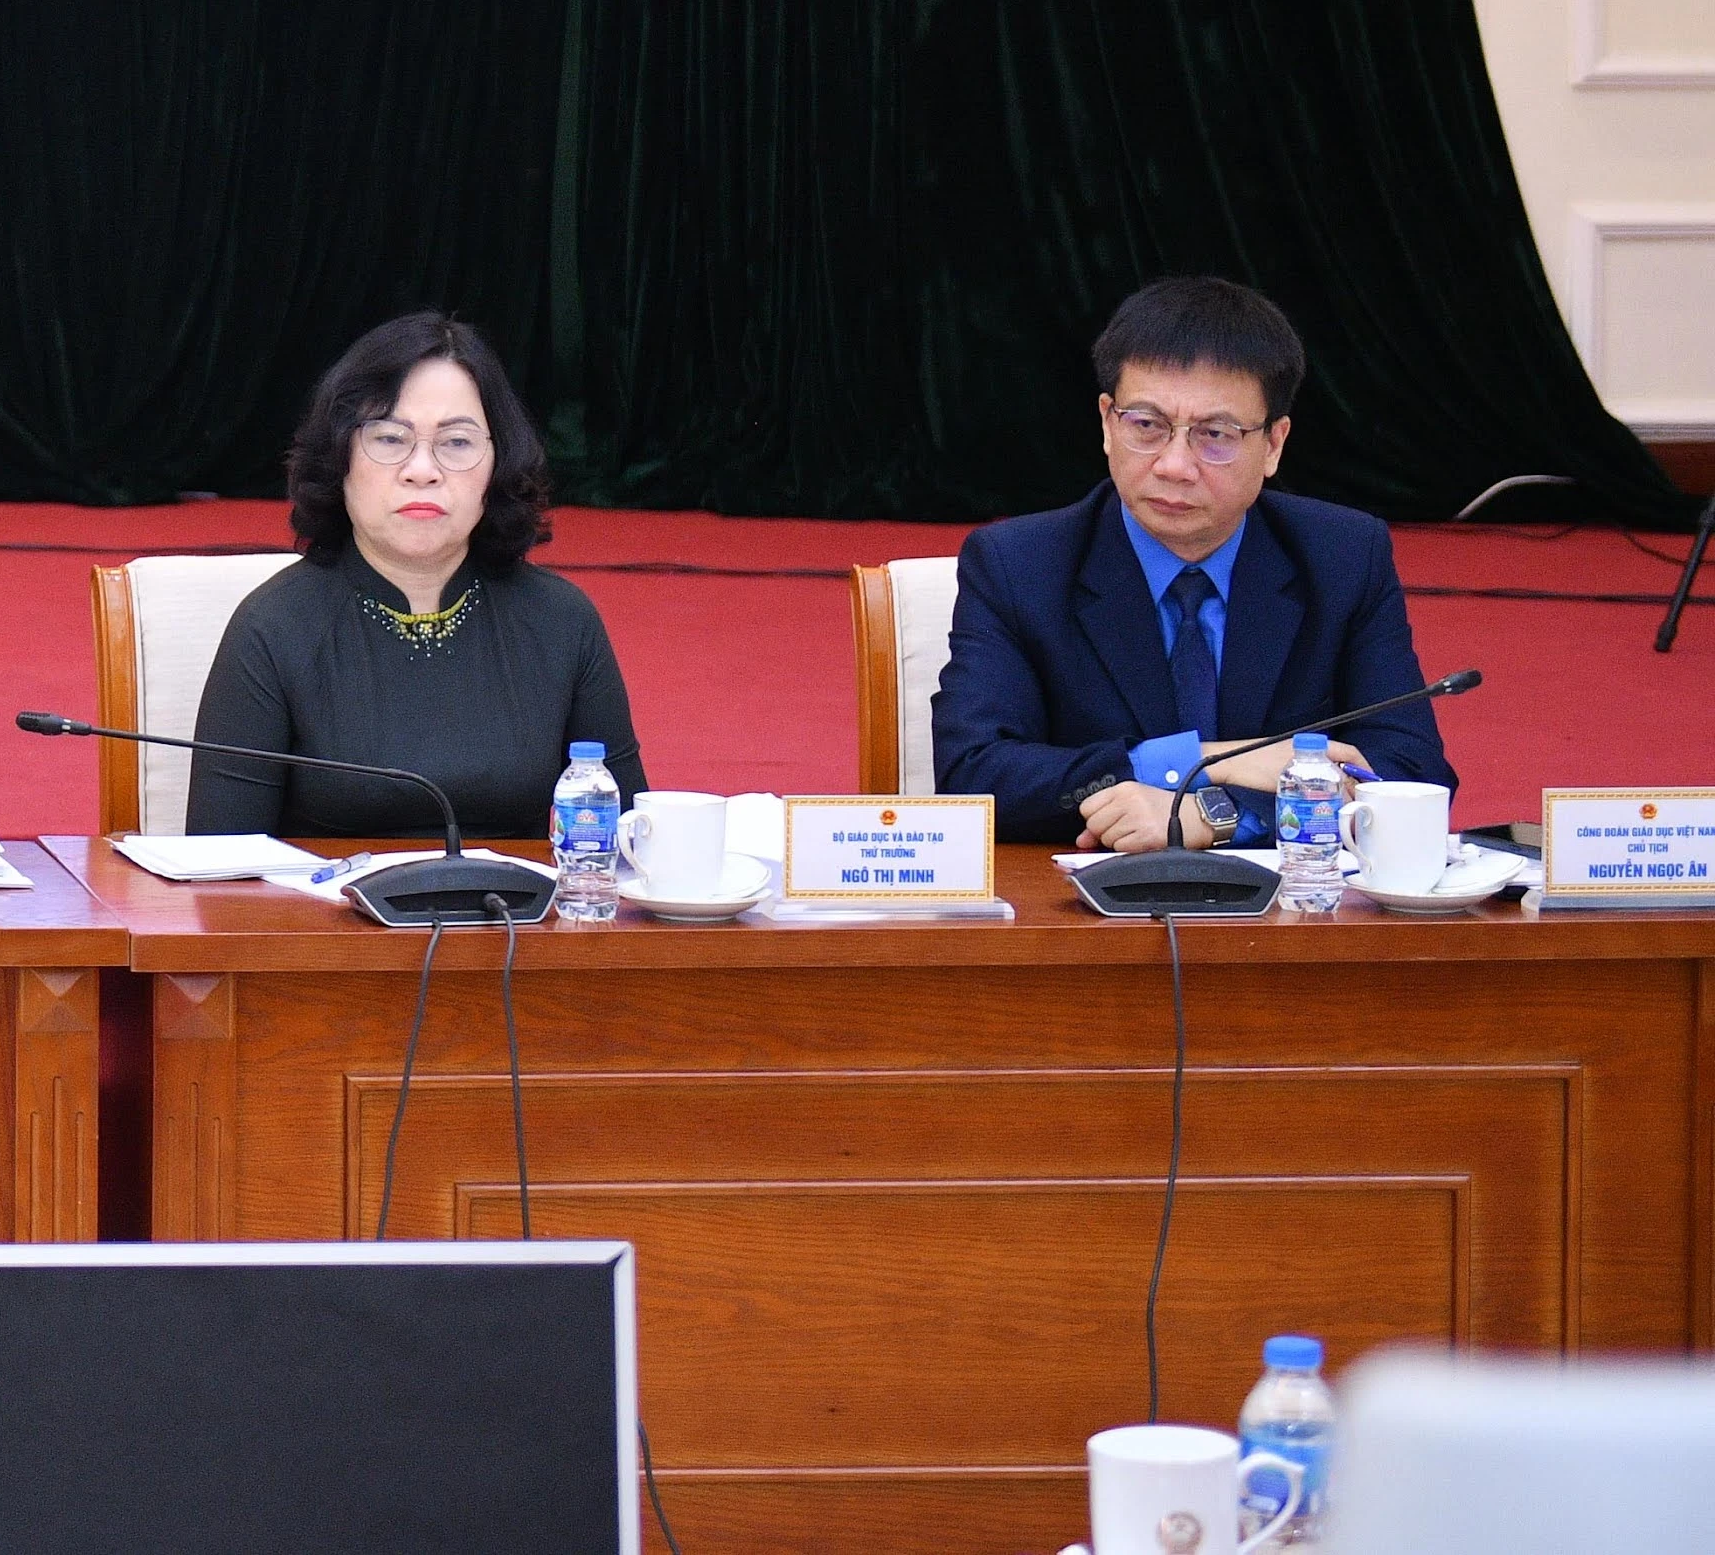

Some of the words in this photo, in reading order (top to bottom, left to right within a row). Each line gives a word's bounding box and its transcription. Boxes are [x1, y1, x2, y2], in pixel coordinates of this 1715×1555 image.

[833, 831, 844, 844] BỘ
[848, 830, 868, 842] GIÁO
[871, 832, 889, 844] DỤC
[892, 830, 903, 842] VÀ
[906, 830, 924, 842] ĐÀO
[927, 832, 943, 844] TẠO
[1577, 826, 1601, 837] CÔNG
[1605, 827, 1629, 837] ĐOÀN
[1632, 826, 1652, 836] GIÁO
[1656, 827, 1673, 838] DỤC
[1677, 825, 1695, 838] VIỆT
[861, 846, 878, 858] THỨ
[881, 845, 915, 858] TRƯỞNG
[1628, 839, 1645, 852] CHỦ
[1649, 843, 1668, 854] TỊCH
[842, 866, 869, 882] NGÔ
[873, 870, 894, 886] THỊ
[899, 870, 934, 882] MINH
[1589, 859, 1642, 878] NGUYỄN
[1647, 863, 1683, 880] NGỌC
[1688, 861, 1706, 877] ÂN
